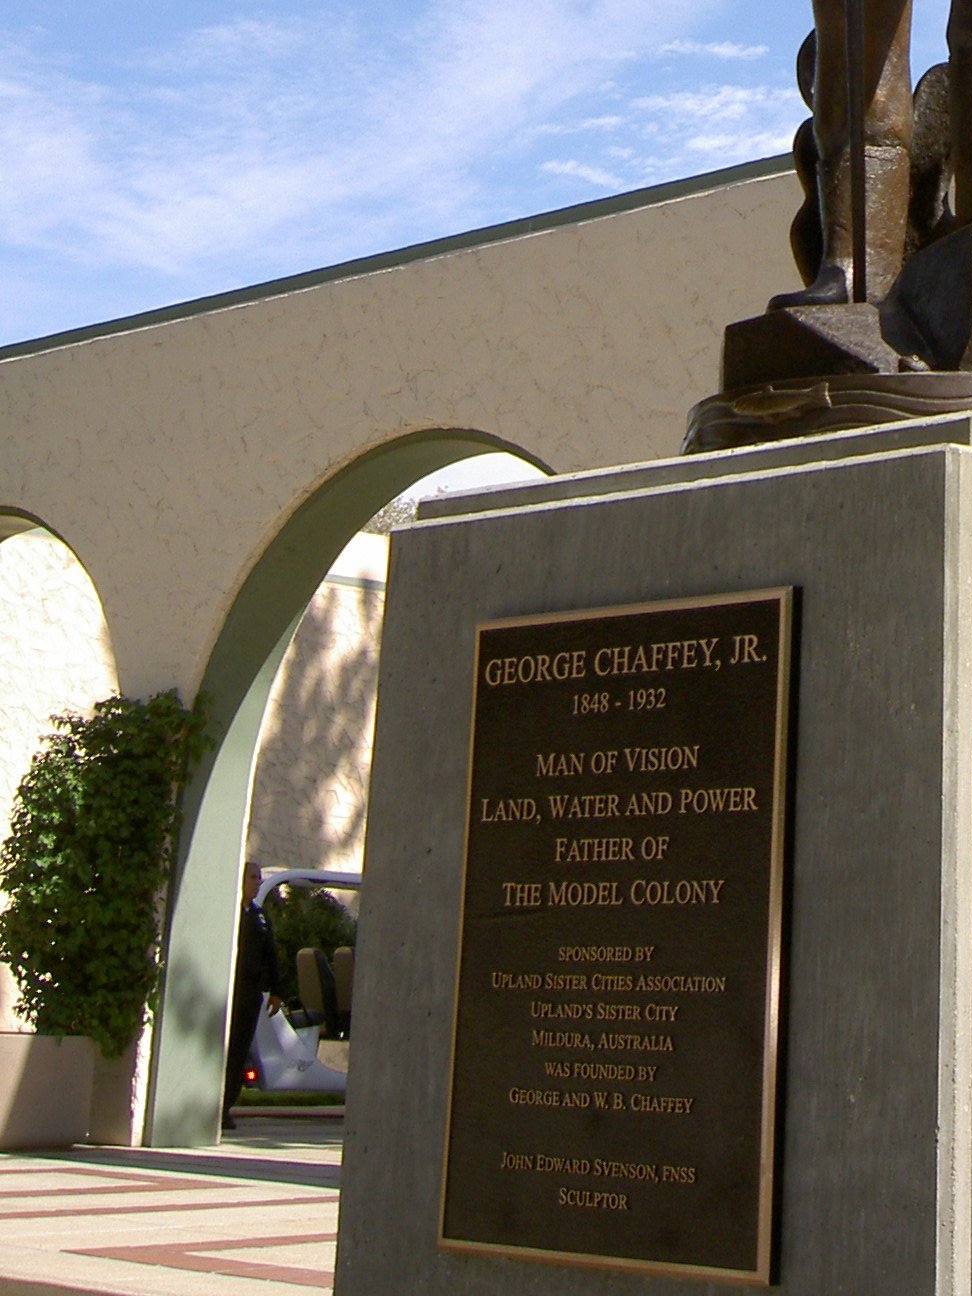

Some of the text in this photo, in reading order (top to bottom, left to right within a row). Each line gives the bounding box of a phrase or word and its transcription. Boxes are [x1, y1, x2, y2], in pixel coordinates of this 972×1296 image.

[485, 635, 768, 686] GEORGE CHAFFEY, JR.
[572, 692, 609, 714] 1848
[629, 688, 666, 711] 1932
[536, 746, 699, 777] MAN OF VISION
[481, 788, 758, 824] LAND, WATER AND POWER
[555, 836, 669, 862] FATHER OF
[502, 880, 725, 906] THE MODEL COLONY
[558, 947, 655, 962] SPONSORED BY
[492, 972, 726, 992] UPLAND SISTER CITIES ASSOCIATION
[597, 1004, 642, 1020] SISTER
[645, 1005, 678, 1022] CITY
[531, 1031, 674, 1051] MILDURA, AUSTRALIA
[544, 1062, 657, 1081] WAS FOUNDED BY
[509, 1088, 693, 1114] GEORGE AND W. B. CHAFFEY
[500, 1152, 696, 1183] JOHN EDWARD SVENSON, FNSS
[559, 1188, 628, 1210] SCULPTOR
